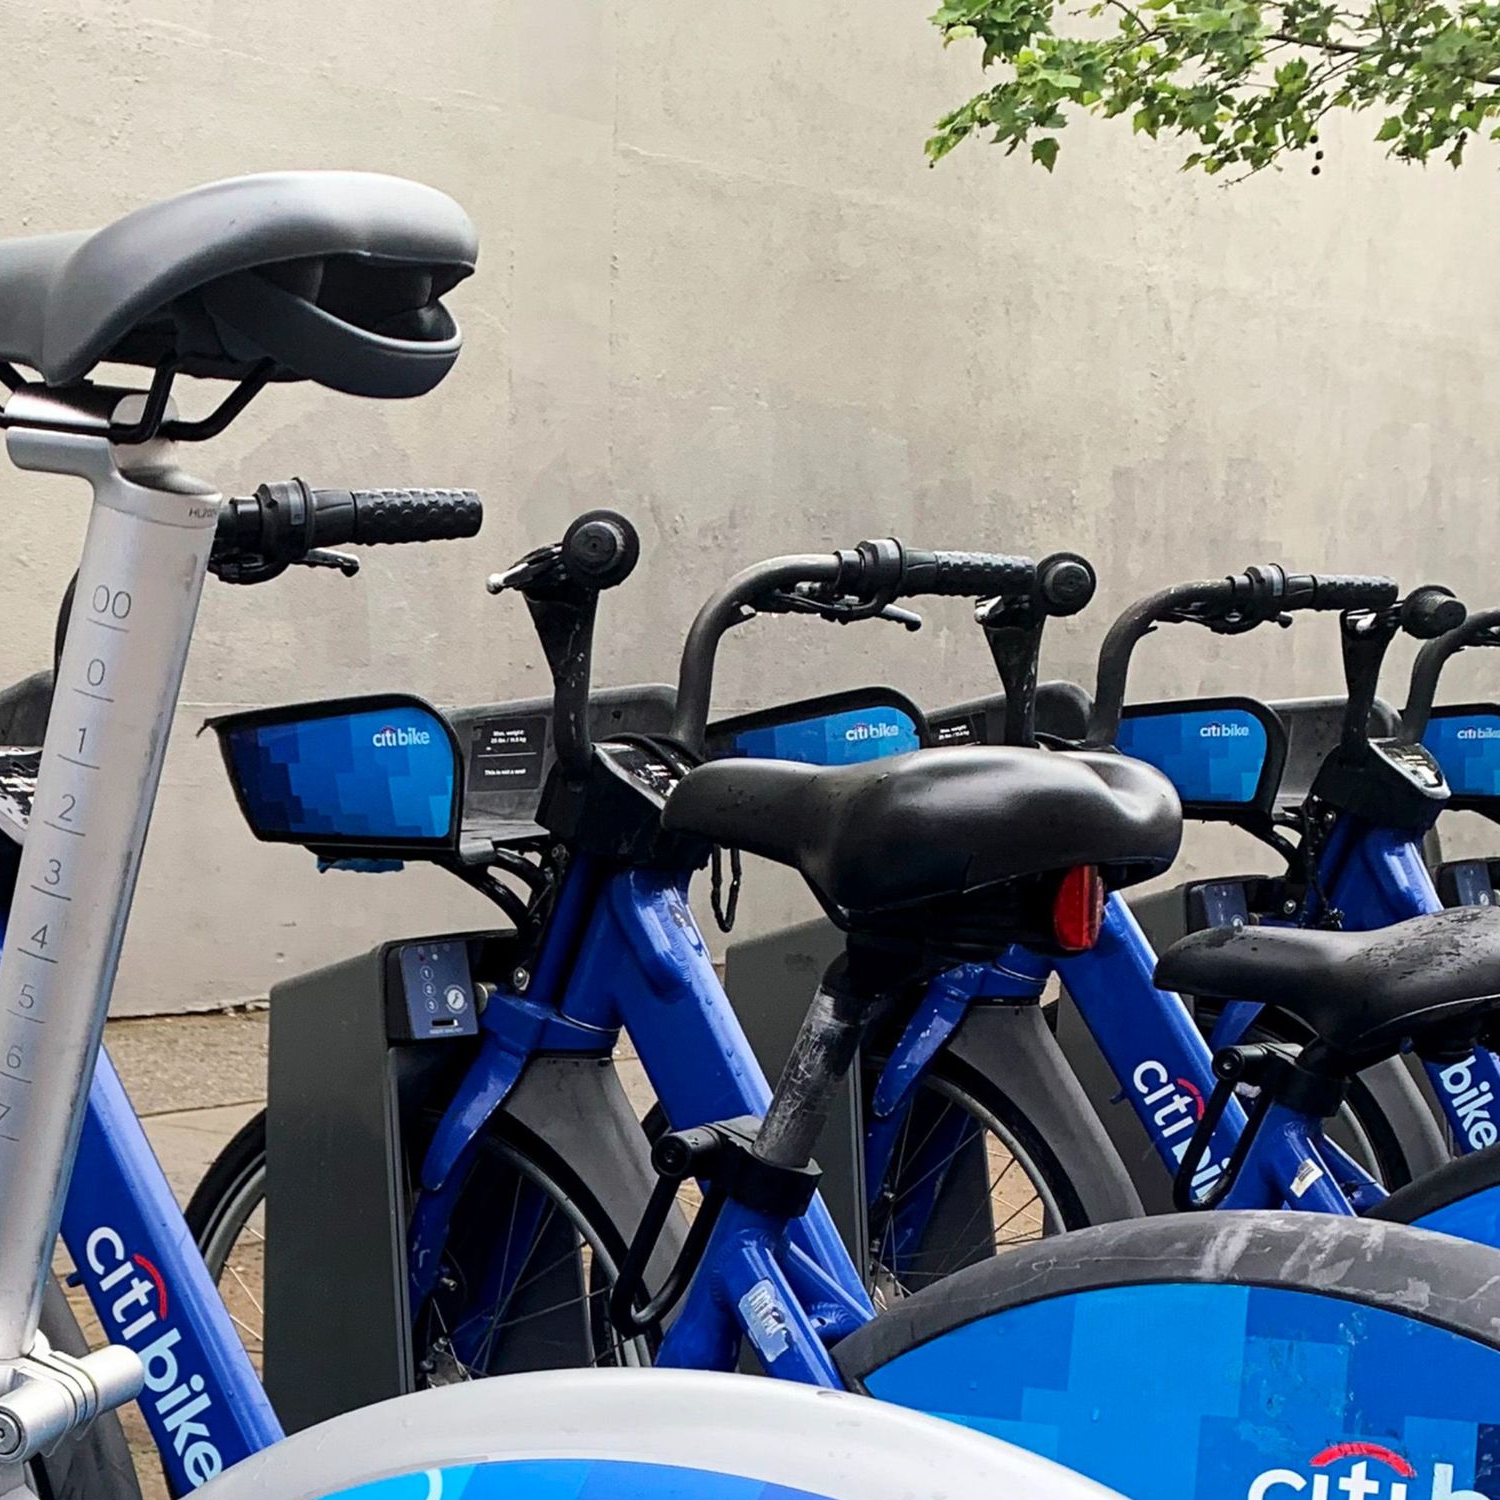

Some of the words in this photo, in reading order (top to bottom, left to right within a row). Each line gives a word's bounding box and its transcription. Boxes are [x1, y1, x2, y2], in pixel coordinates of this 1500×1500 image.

[92, 584, 132, 619] 00
[87, 658, 106, 687] 0
[78, 727, 87, 755] 1
[372, 725, 397, 748] citi
[397, 726, 431, 747] bike
[845, 724, 868, 742] citi
[869, 723, 900, 739] bike
[1200, 722, 1221, 737] citi
[1221, 723, 1250, 737] bike
[1457, 726, 1477, 740] citi
[58, 794, 76, 822] 2
[44, 859, 62, 886] 3
[31, 924, 49, 950] 4
[18, 984, 35, 1010] 5
[6, 1046, 23, 1069] 6
[1133, 1060, 1205, 1138] citi
[1439, 1055, 1498, 1151] bike
[86, 1226, 166, 1341] citi
[137, 1327, 223, 1489] bike
